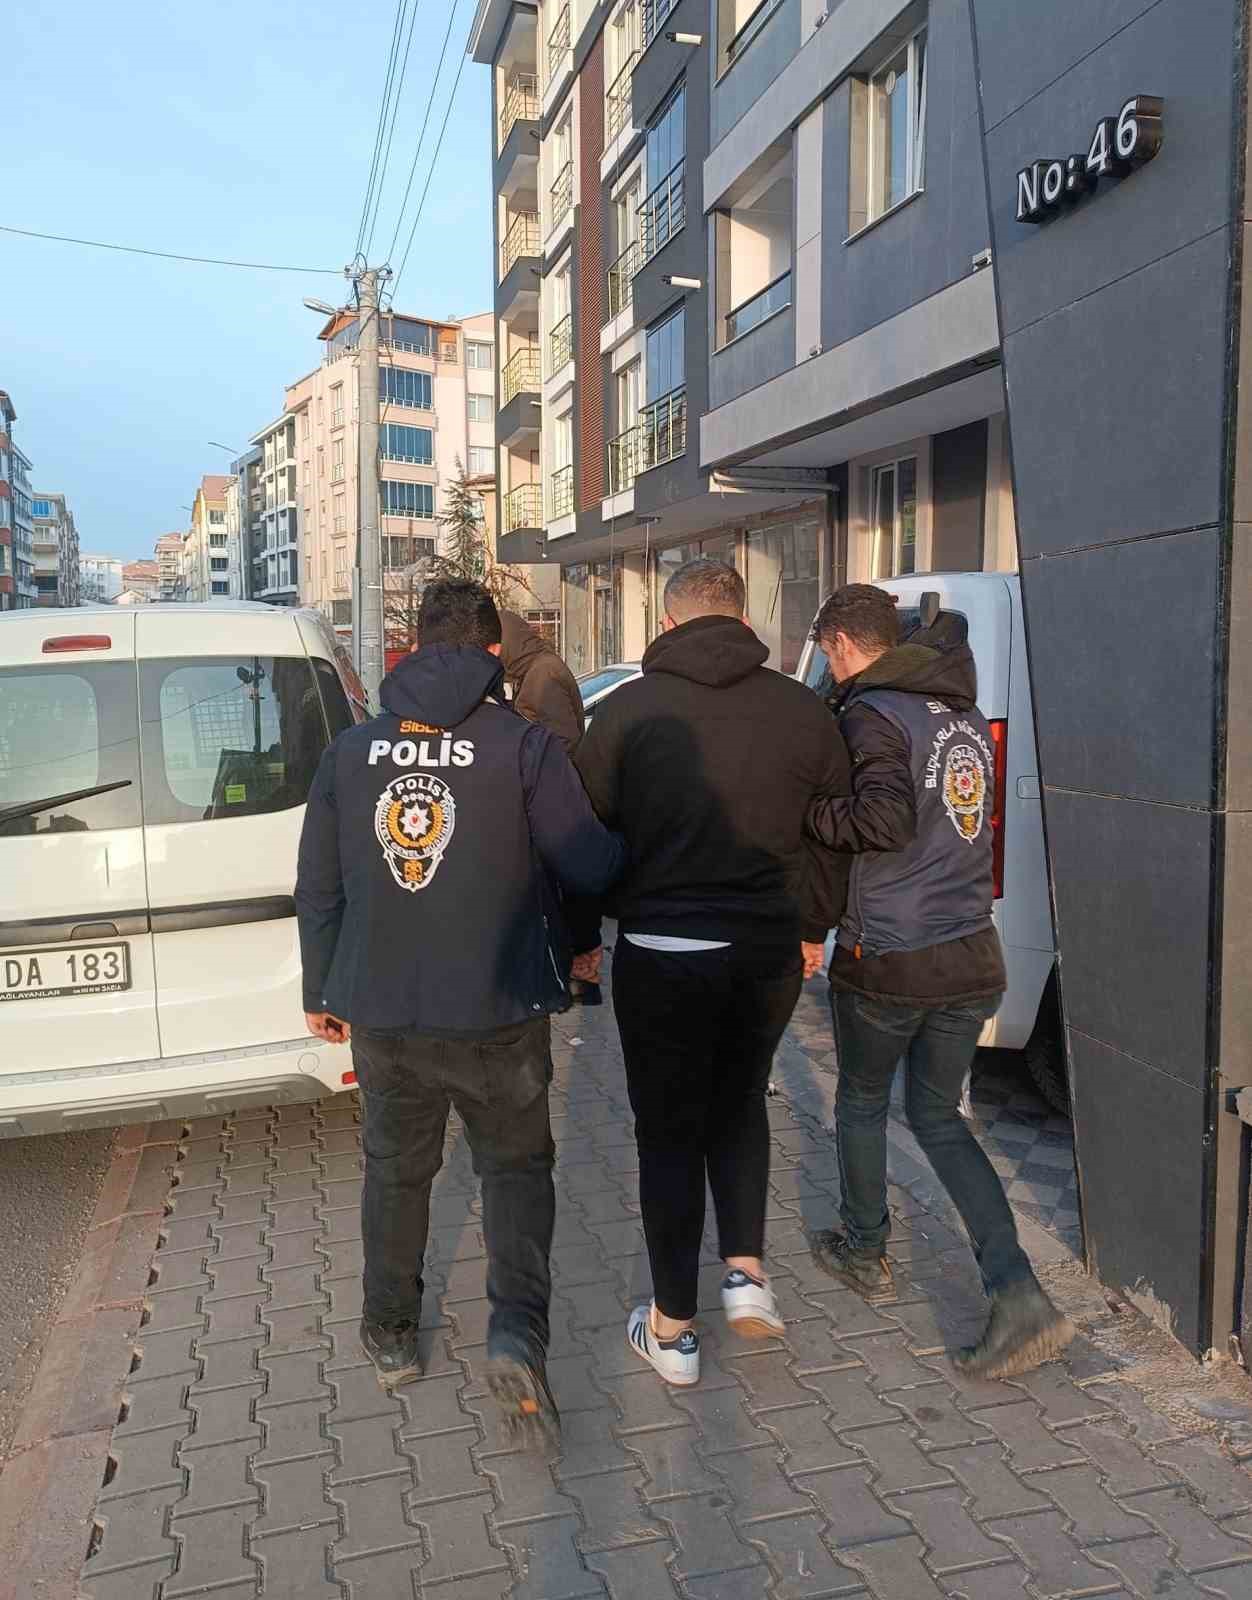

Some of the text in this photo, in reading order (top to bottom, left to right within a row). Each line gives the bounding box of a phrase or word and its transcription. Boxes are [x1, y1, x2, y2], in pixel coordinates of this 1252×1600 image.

[1016, 98, 1142, 220] No: 46
[367, 731, 475, 767] POLİS
[395, 777, 443, 797] POLİS
[5, 951, 120, 988] DA 183
